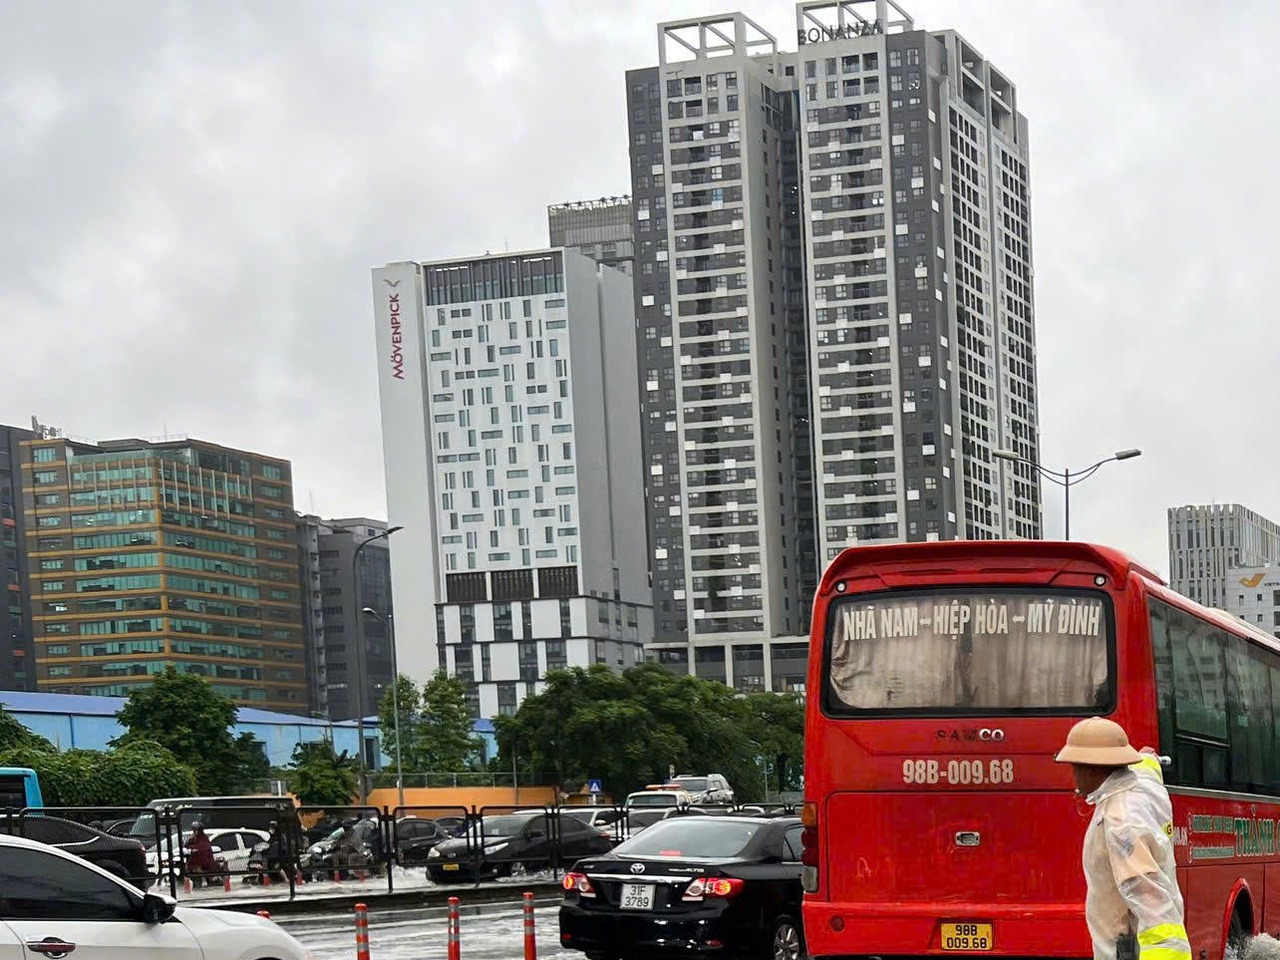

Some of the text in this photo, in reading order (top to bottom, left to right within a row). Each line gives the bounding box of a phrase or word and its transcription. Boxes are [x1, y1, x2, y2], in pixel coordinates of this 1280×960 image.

[798, 19, 884, 45] BONANZA
[389, 293, 404, 380] MÖVENPICK
[844, 599, 1100, 641] NHÃ NAM HIỆP HÒA MỸ ĐÌNH
[903, 759, 1014, 785] 98B-009.68
[631, 885, 646, 896] 31F
[625, 897, 649, 908] 3789
[955, 924, 978, 936] 98B
[946, 937, 988, 949] 009.68
